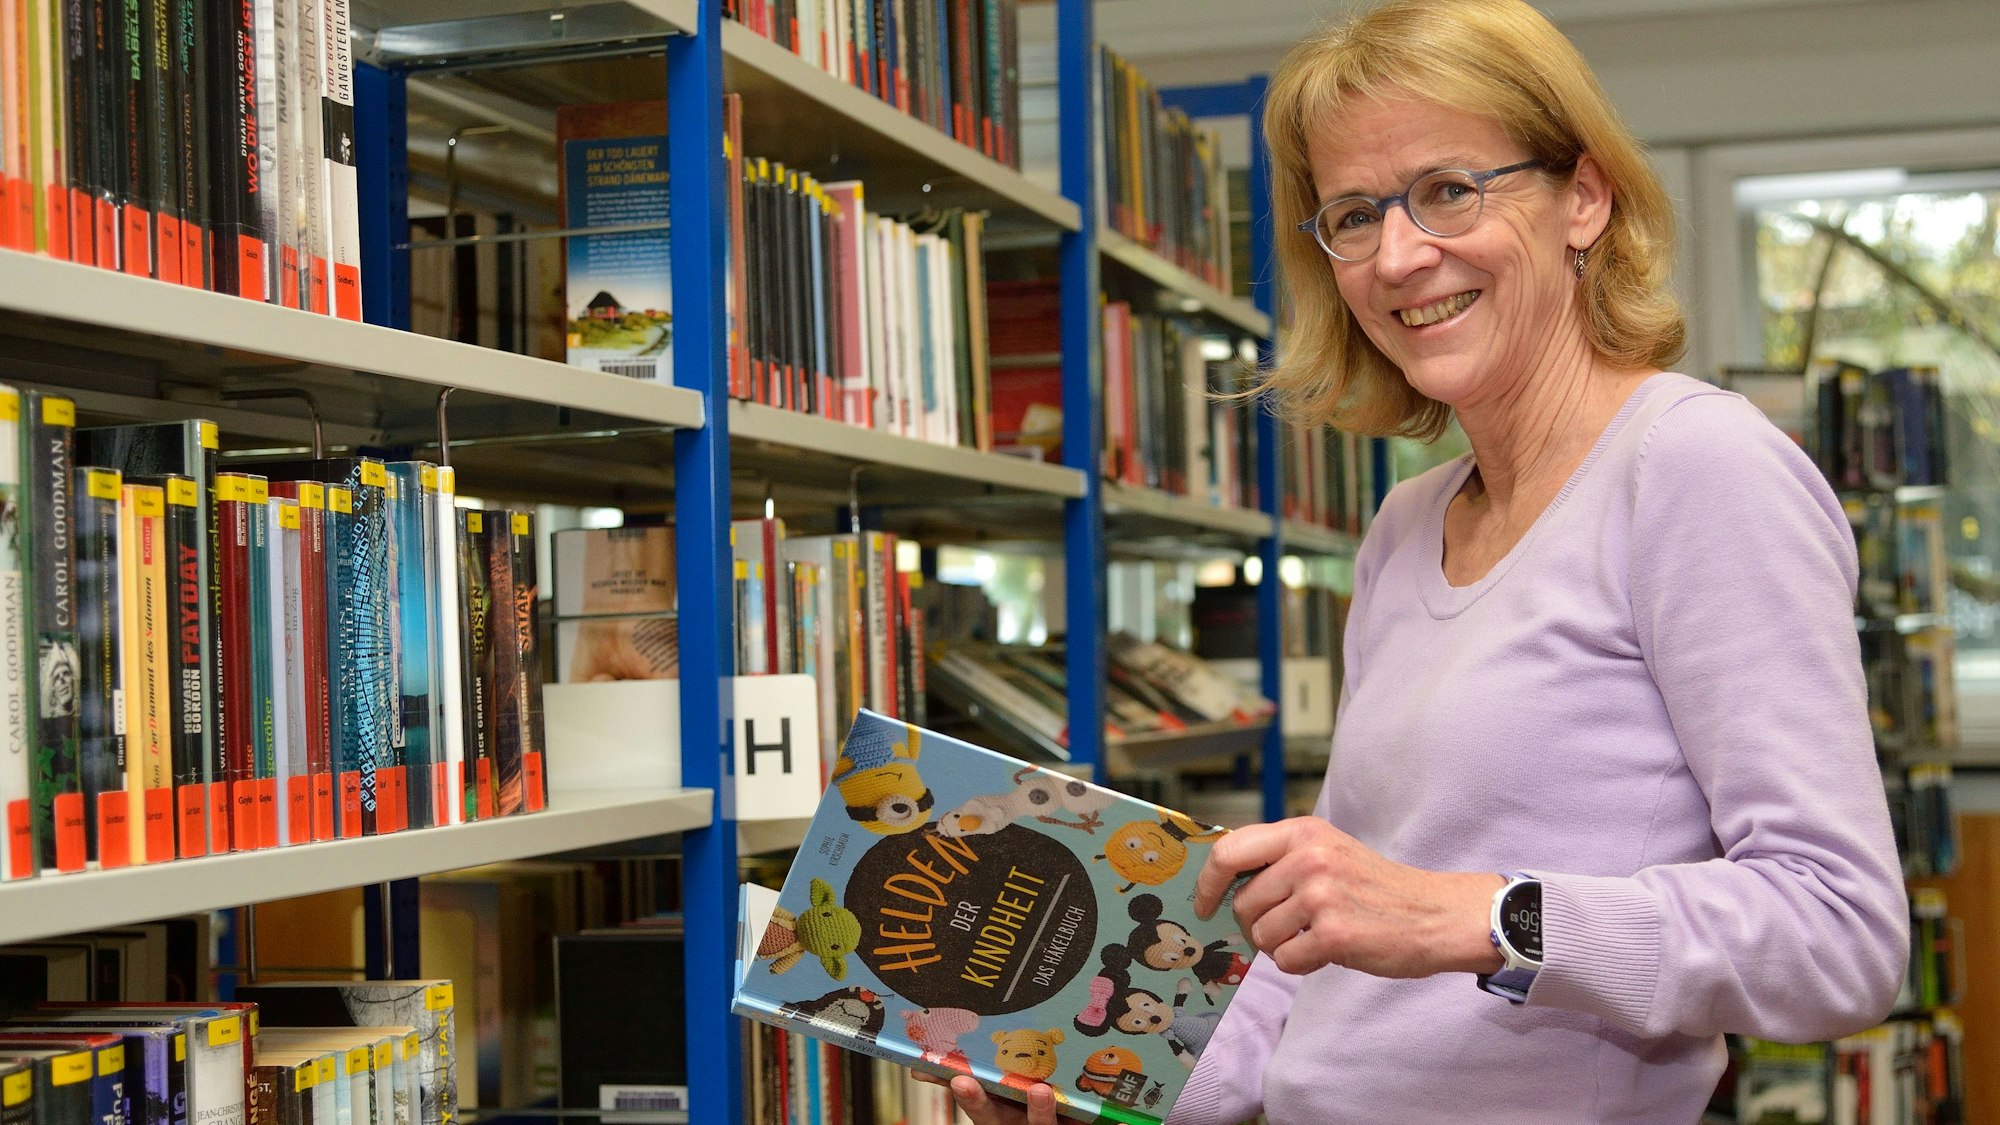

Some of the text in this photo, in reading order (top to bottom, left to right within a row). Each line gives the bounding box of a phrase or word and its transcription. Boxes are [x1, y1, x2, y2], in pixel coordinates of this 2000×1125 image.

[131, 0, 141, 80] BABELS
[160, 0, 169, 70] CHARLOTTE
[181, 0, 190, 74] ASKANISC
[335, 0, 350, 100] GANGSTERLAN
[236, 29, 248, 158] DINAH MARTE GOLCH
[242, 0, 260, 194] WO DIE ANGST IST
[50, 438, 69, 627] CAROL GOODMAN
[142, 576, 154, 640] Salomon
[179, 542, 200, 664] PAYDAY
[515, 585, 531, 651] SATAN
[3, 574, 21, 755] CAROL GOODMAN
[145, 640, 155, 664] des
[216, 640, 225, 694] GORDON
[344, 586, 356, 699] DER STILLE
[375, 587, 388, 759] KILL MR BITCOIN
[147, 667, 158, 730] Diamant
[183, 668, 192, 734] HOWARD
[192, 668, 202, 734] GORDON
[321, 676, 329, 773] bersommer
[474, 676, 485, 758] RICK GRAHAM
[519, 671, 529, 722] GRAHAM
[117, 736, 125, 766] Diana
[149, 729, 159, 757] Der
[217, 712, 227, 769] WILLIAM
[245, 744, 254, 780] tage
[263, 696, 276, 778] egestöber
[745, 717, 792, 775] H
[818, 835, 835, 856] SOPHIE
[873, 834, 980, 974] HELDEN
[949, 900, 982, 932] DER
[960, 865, 1045, 988] KINDHEIT
[1519, 909, 1539, 933] 56
[1032, 905, 1087, 988] DAS HÄKELBUCH
[438, 1013, 449, 1057] PAR
[247, 1071, 258, 1125] NGÉ
[1115, 1073, 1138, 1102] EMF
